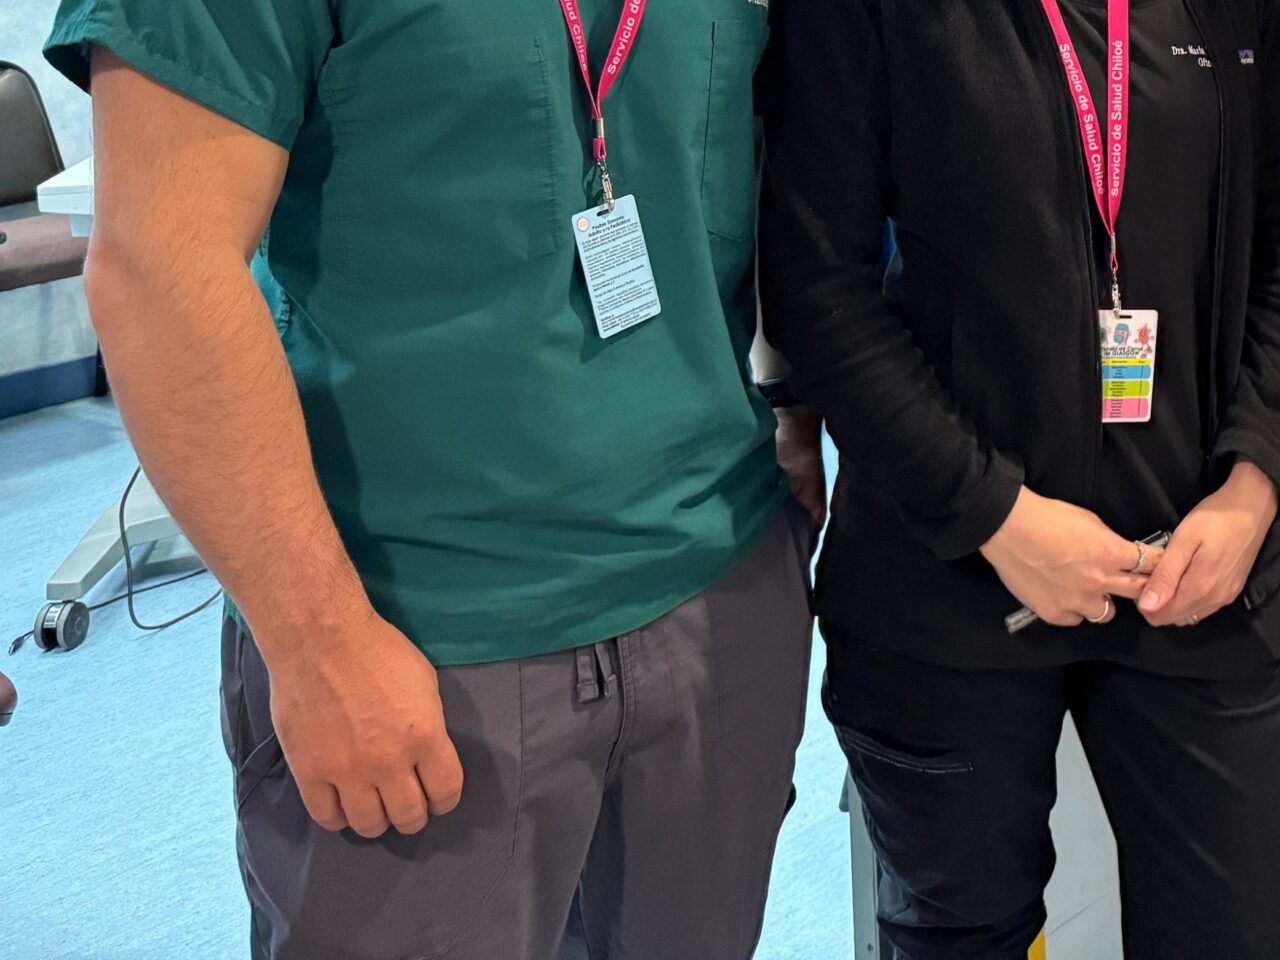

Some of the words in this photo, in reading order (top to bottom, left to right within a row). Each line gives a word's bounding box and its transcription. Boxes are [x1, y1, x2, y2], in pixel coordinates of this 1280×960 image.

[607, 17, 635, 75] Servicio
[1111, 40, 1123, 81] Chiloé
[1060, 43, 1083, 93] Servicio
[1078, 95, 1089, 111] de
[1111, 83, 1123, 120] Salud
[1083, 113, 1099, 151] Salud
[1111, 124, 1122, 140] de
[1111, 143, 1122, 197] Servicio
